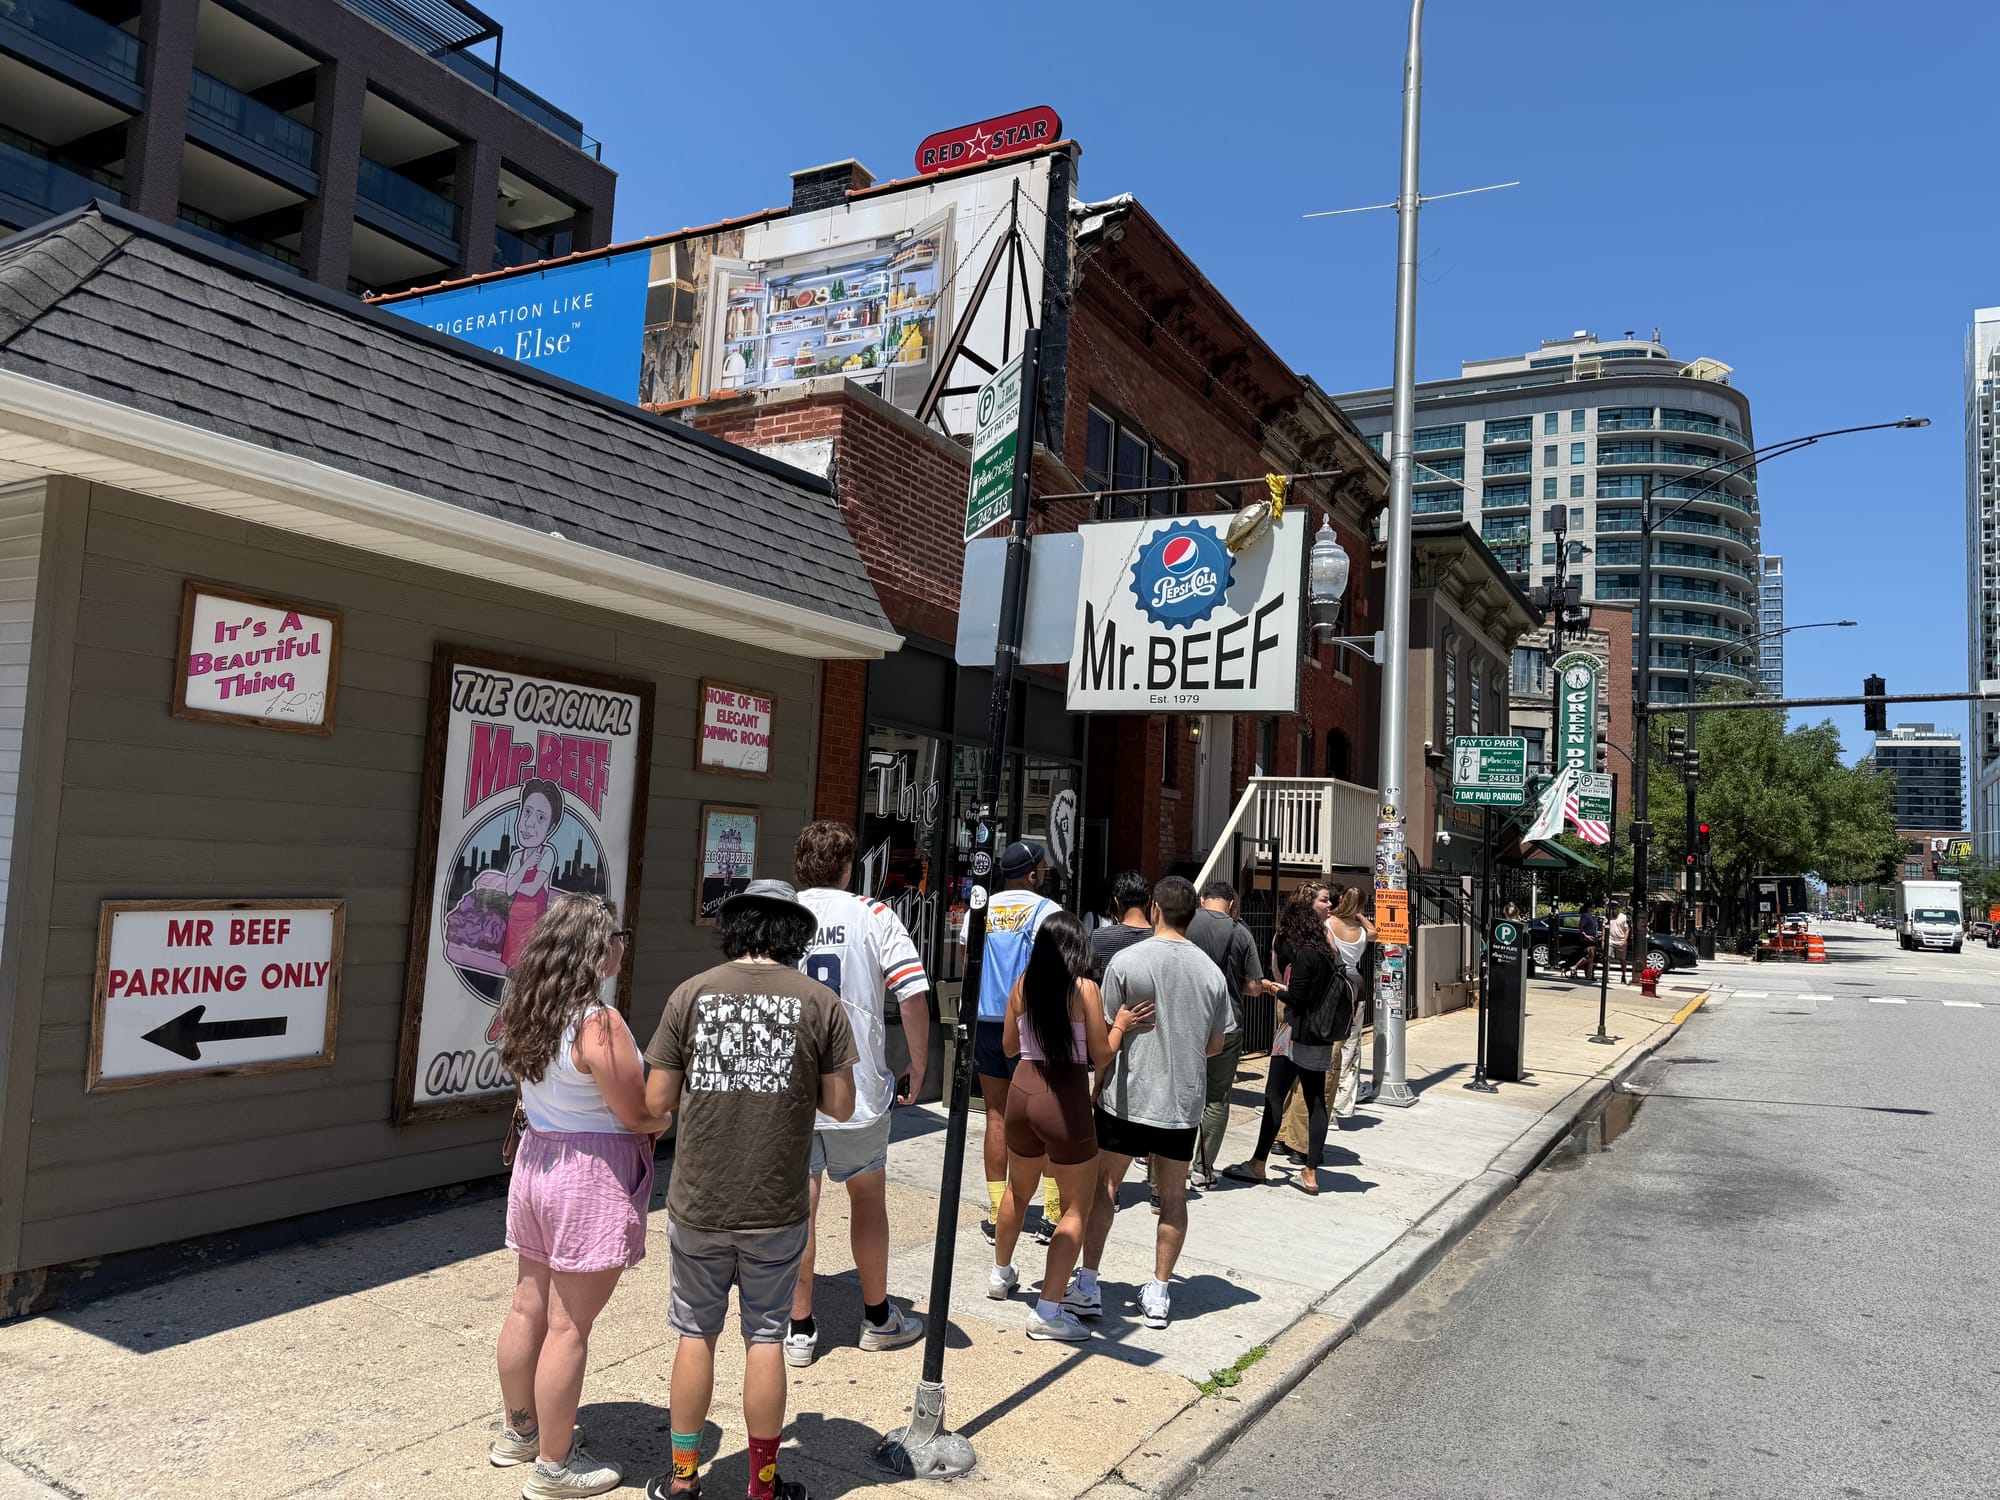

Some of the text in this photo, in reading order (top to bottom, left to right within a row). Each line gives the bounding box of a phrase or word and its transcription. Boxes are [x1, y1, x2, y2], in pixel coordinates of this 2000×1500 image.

[922, 120, 1048, 167] RED STAR
[553, 293, 593, 314] LIKE
[977, 433, 987, 447] PAY
[987, 427, 994, 440] AT
[995, 416, 1005, 434] PAY
[1006, 405, 1018, 424] BOX
[977, 507, 992, 528] 242
[993, 495, 1009, 517] 413
[279, 610, 303, 633] A
[452, 670, 633, 736] THE ORIGINAL
[706, 688, 770, 714] HOME OF THE
[1149, 695, 1200, 704] Est. 1979
[716, 708, 760, 729] ELEGANT
[1566, 690, 1588, 744] GREEN
[703, 724, 769, 748] DINING ROOM
[869, 750, 940, 828] The
[1455, 791, 1522, 801] 7 DAY PAID PARKING
[705, 851, 753, 864] ROOT BEER
[167, 918, 291, 947] MR BEEF
[107, 961, 330, 998] PARKING ONLY
[425, 1049, 476, 1096] ON
